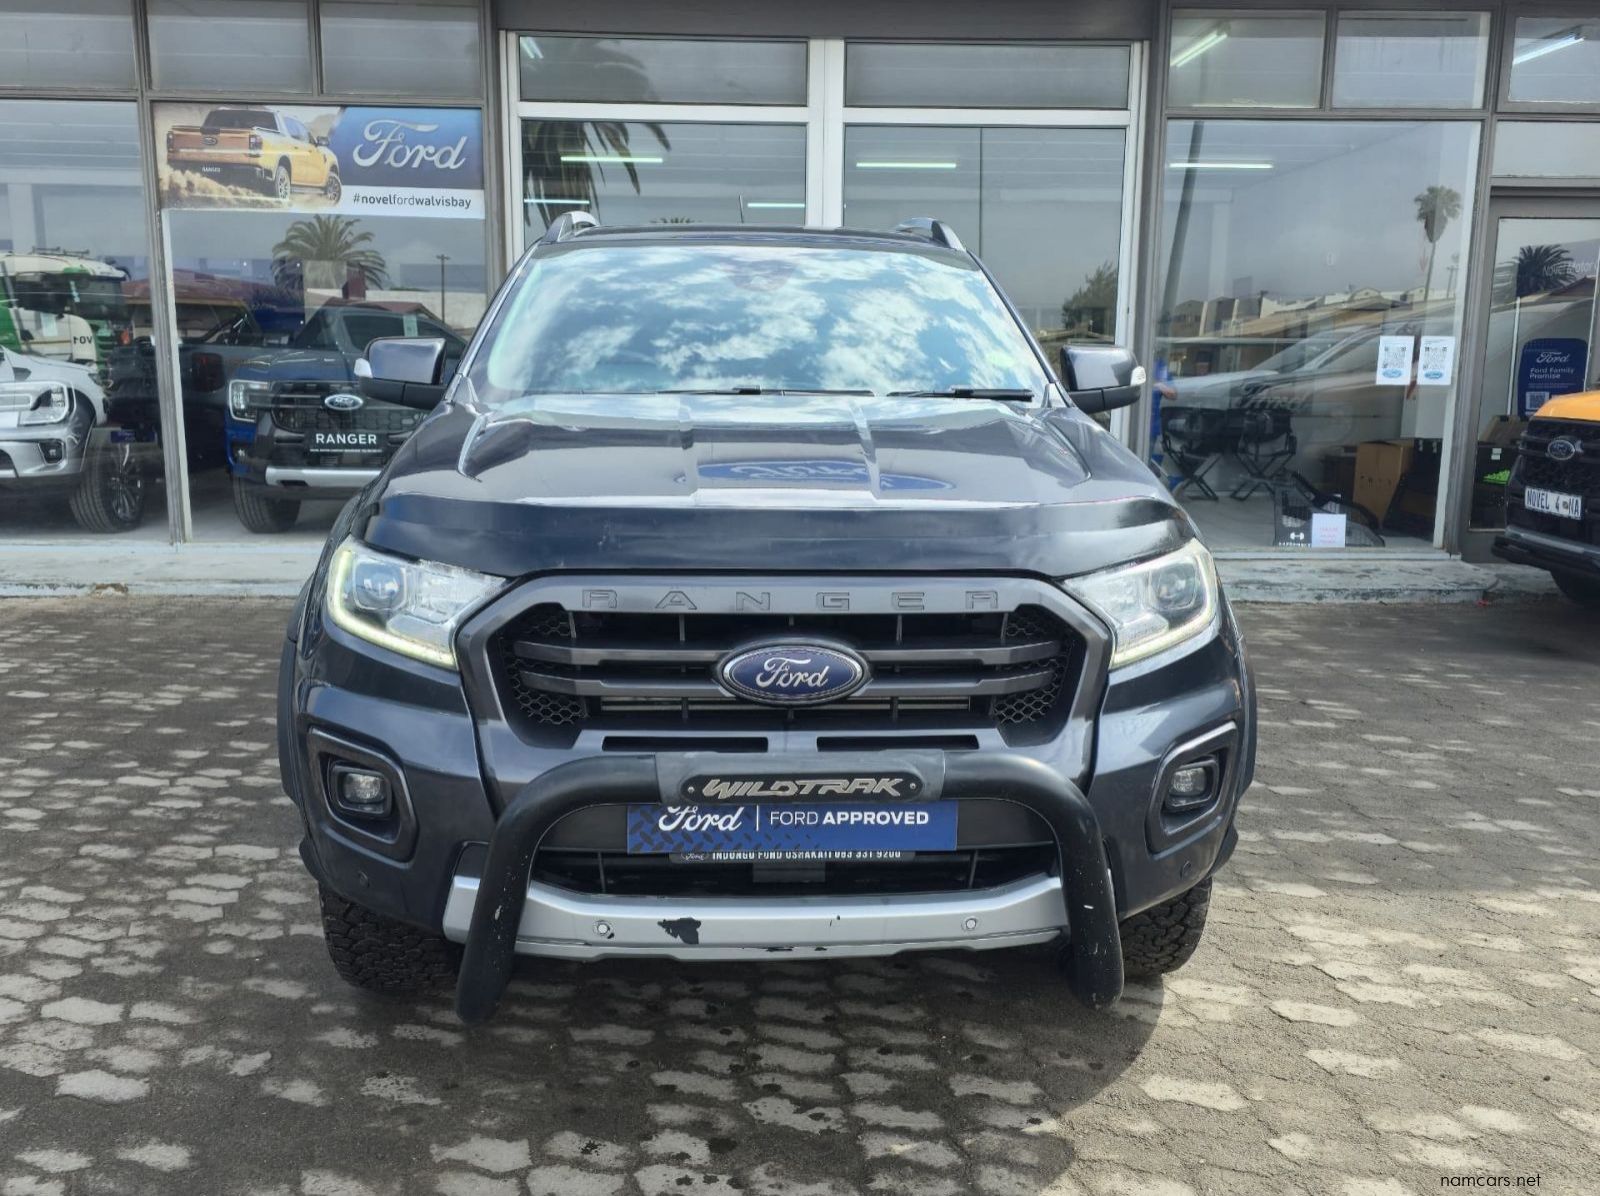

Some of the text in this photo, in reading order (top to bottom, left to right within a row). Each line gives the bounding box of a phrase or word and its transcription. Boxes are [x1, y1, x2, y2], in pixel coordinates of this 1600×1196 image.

[353, 119, 469, 169] Ford
[353, 194, 472, 208] #novelfordwalvisbay
[1536, 352, 1571, 363] Ford
[315, 433, 377, 444] RANGER
[1526, 489, 1550, 510] NOVEL
[1568, 498, 1580, 516] NA
[582, 589, 999, 611] RANGER
[756, 657, 831, 688] Ford
[702, 778, 904, 799] WILDTRAK
[658, 805, 929, 832] Ford FORD APPROVED
